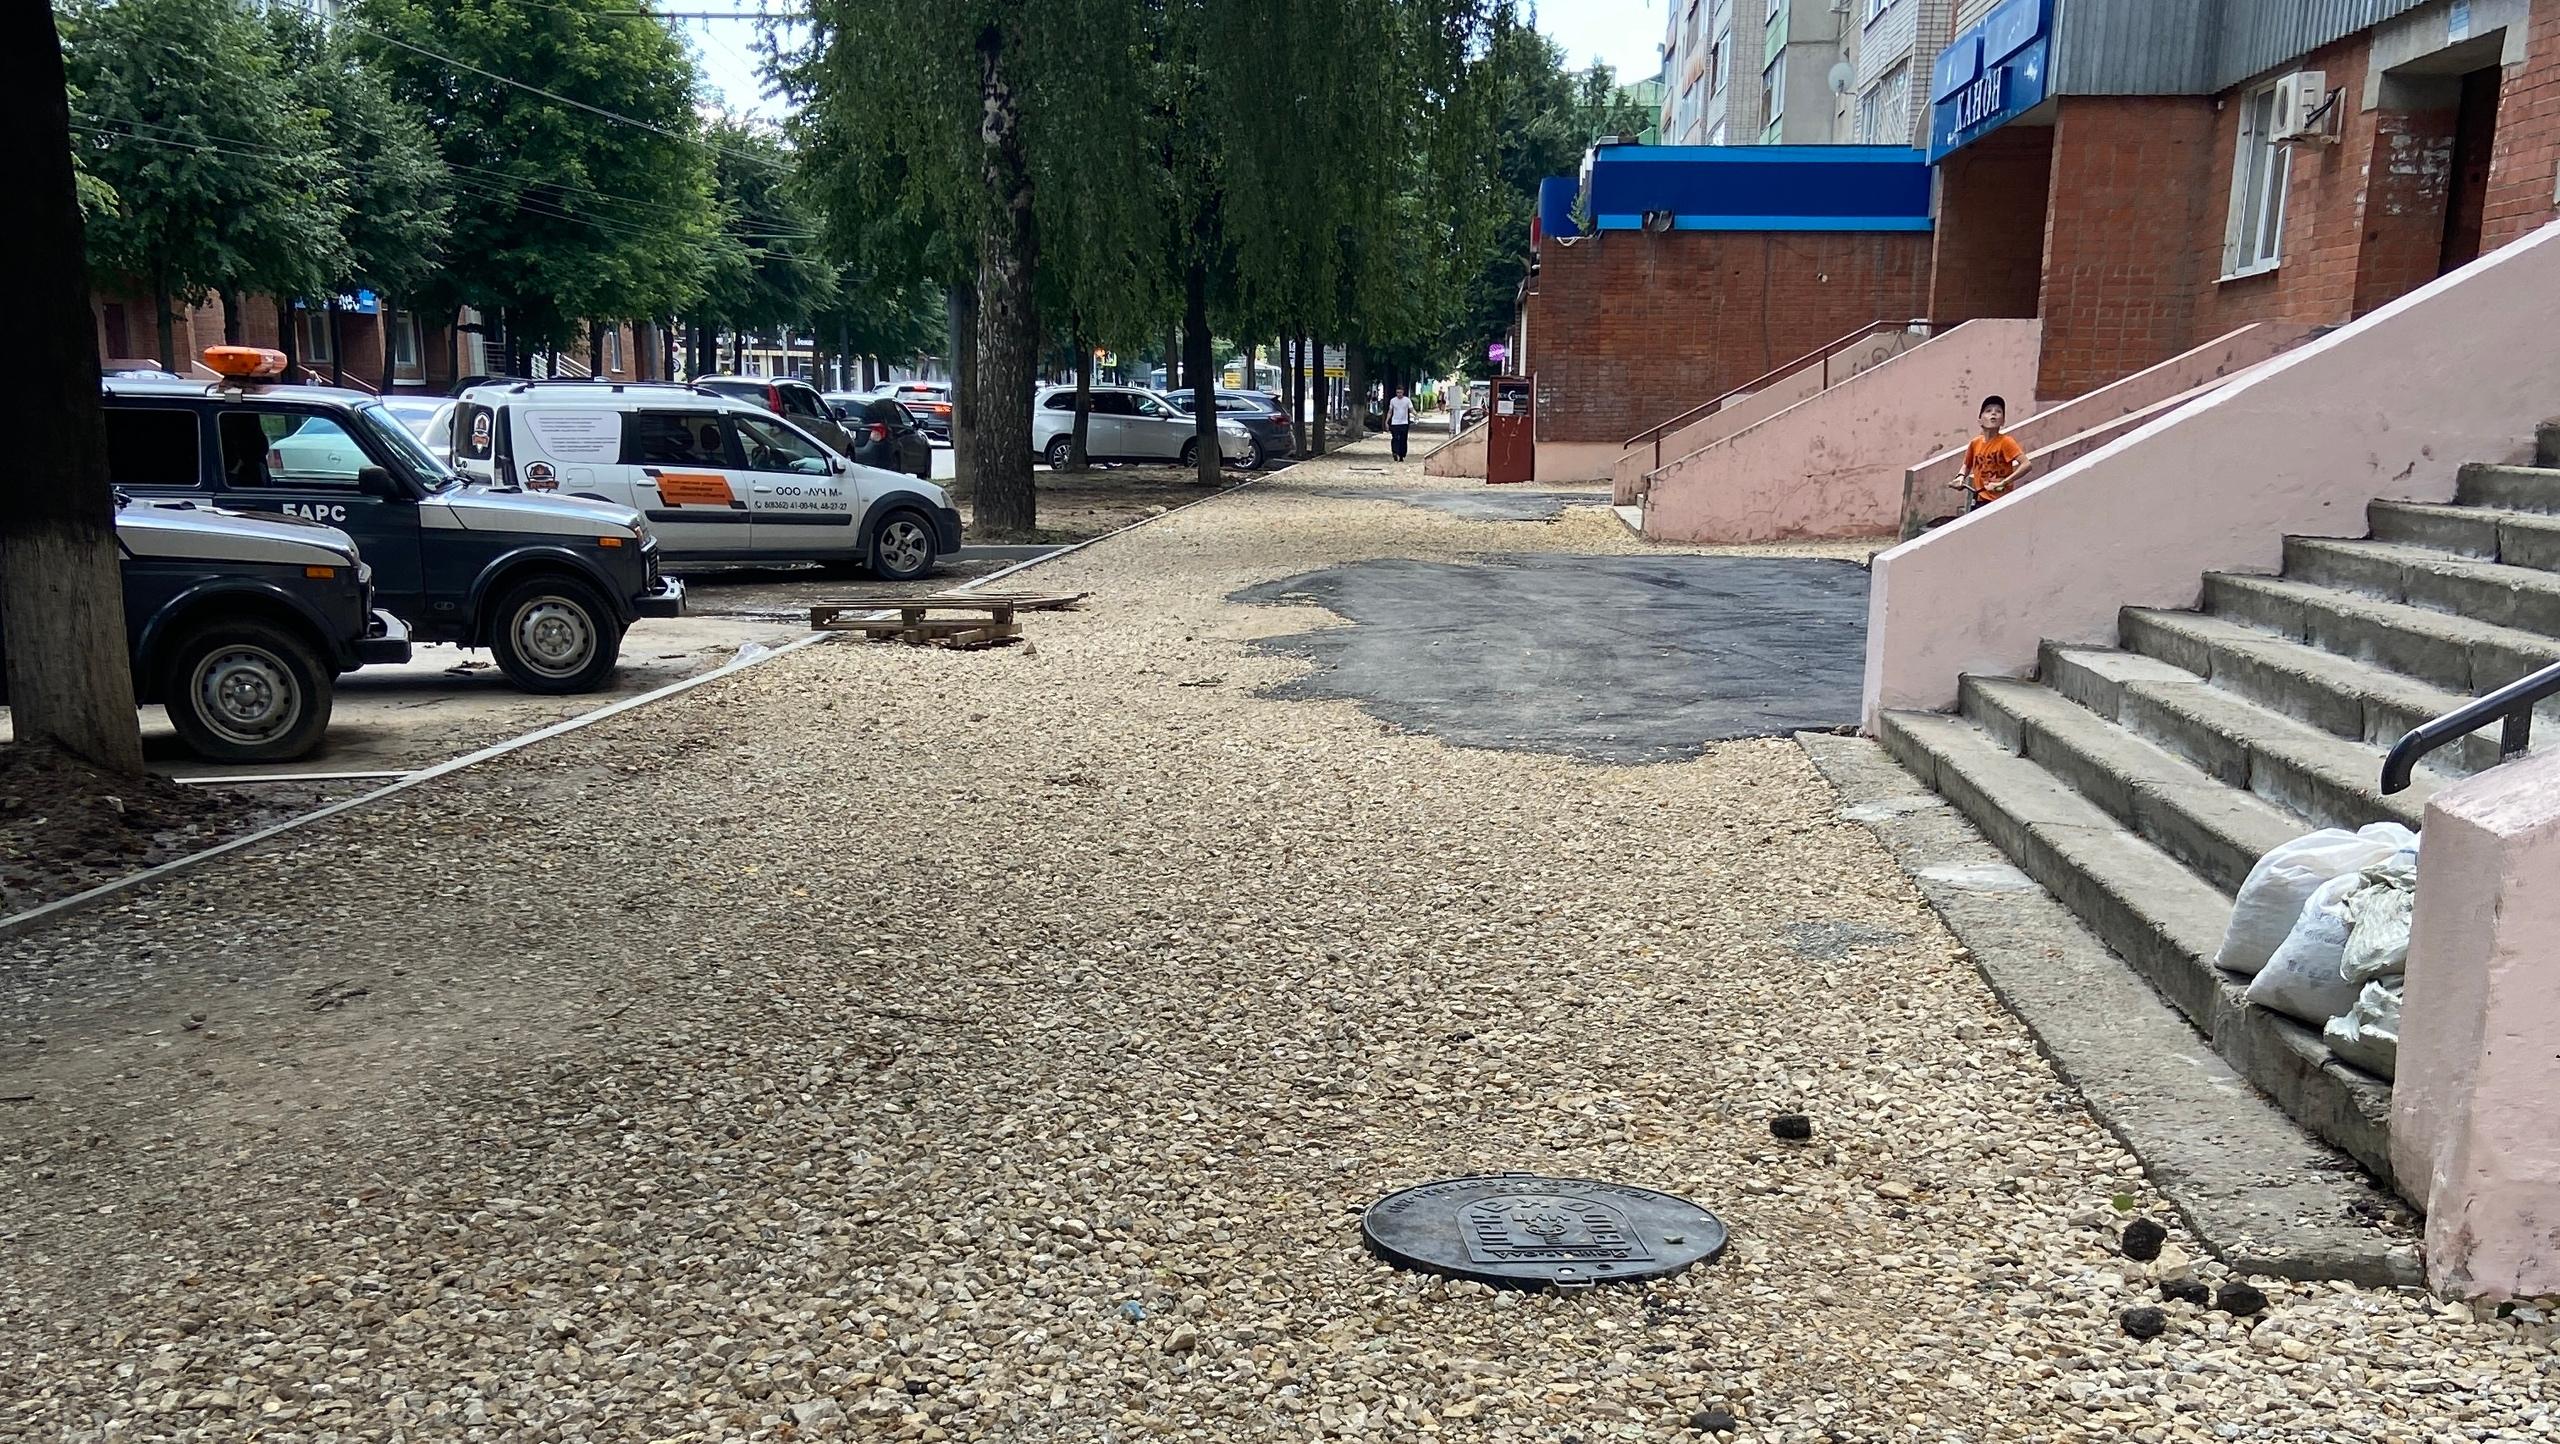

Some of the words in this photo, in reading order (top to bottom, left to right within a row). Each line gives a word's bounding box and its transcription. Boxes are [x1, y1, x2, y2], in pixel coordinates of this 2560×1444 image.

[1954, 65, 2003, 133] КАНОН
[776, 486, 801, 496] ООО
[764, 501, 789, 509] 8(8362)
[282, 503, 347, 522] БАРС
